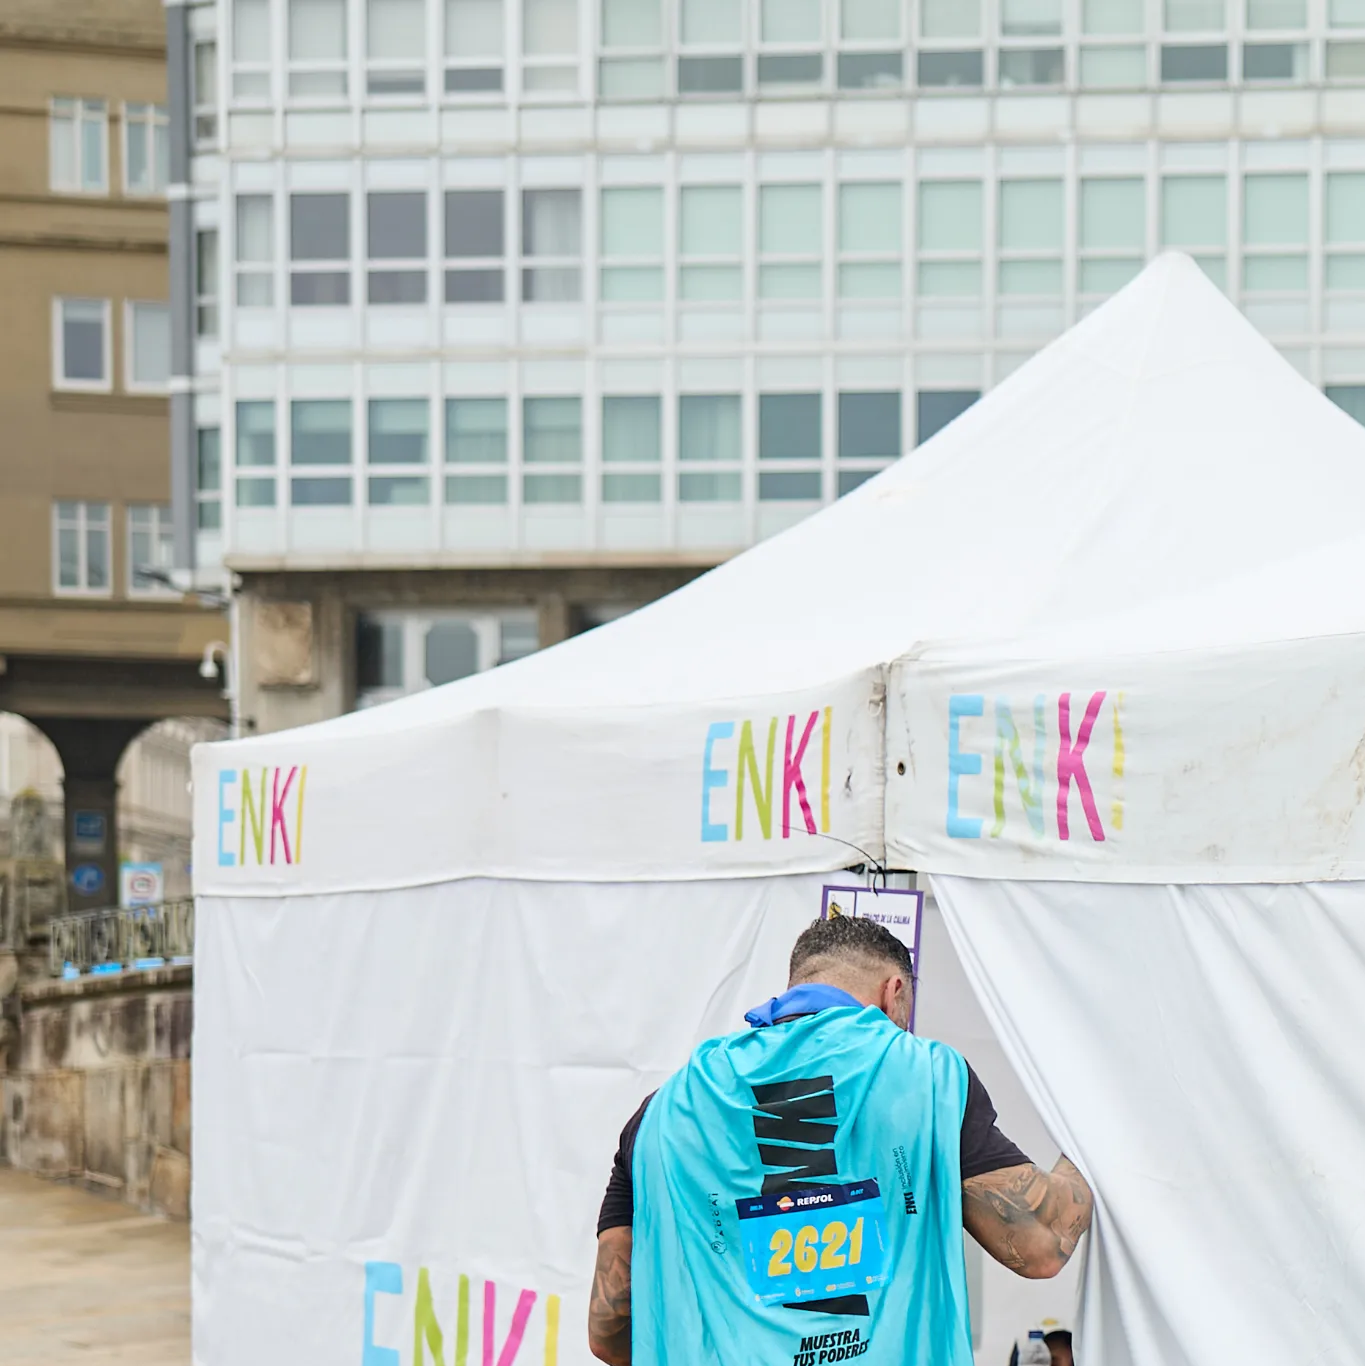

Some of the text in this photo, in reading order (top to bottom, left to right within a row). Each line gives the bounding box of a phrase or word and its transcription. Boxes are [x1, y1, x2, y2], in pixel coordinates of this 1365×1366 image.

[700, 705, 832, 842] ENKI
[946, 691, 1125, 842] ENKI
[218, 764, 308, 867] ENKI
[797, 1194, 833, 1207] REPSOL
[903, 1191, 918, 1215] ENKI
[767, 1216, 864, 1278] 2621
[800, 1328, 860, 1353] MUESTRA
[818, 1338, 870, 1365] PODERES
